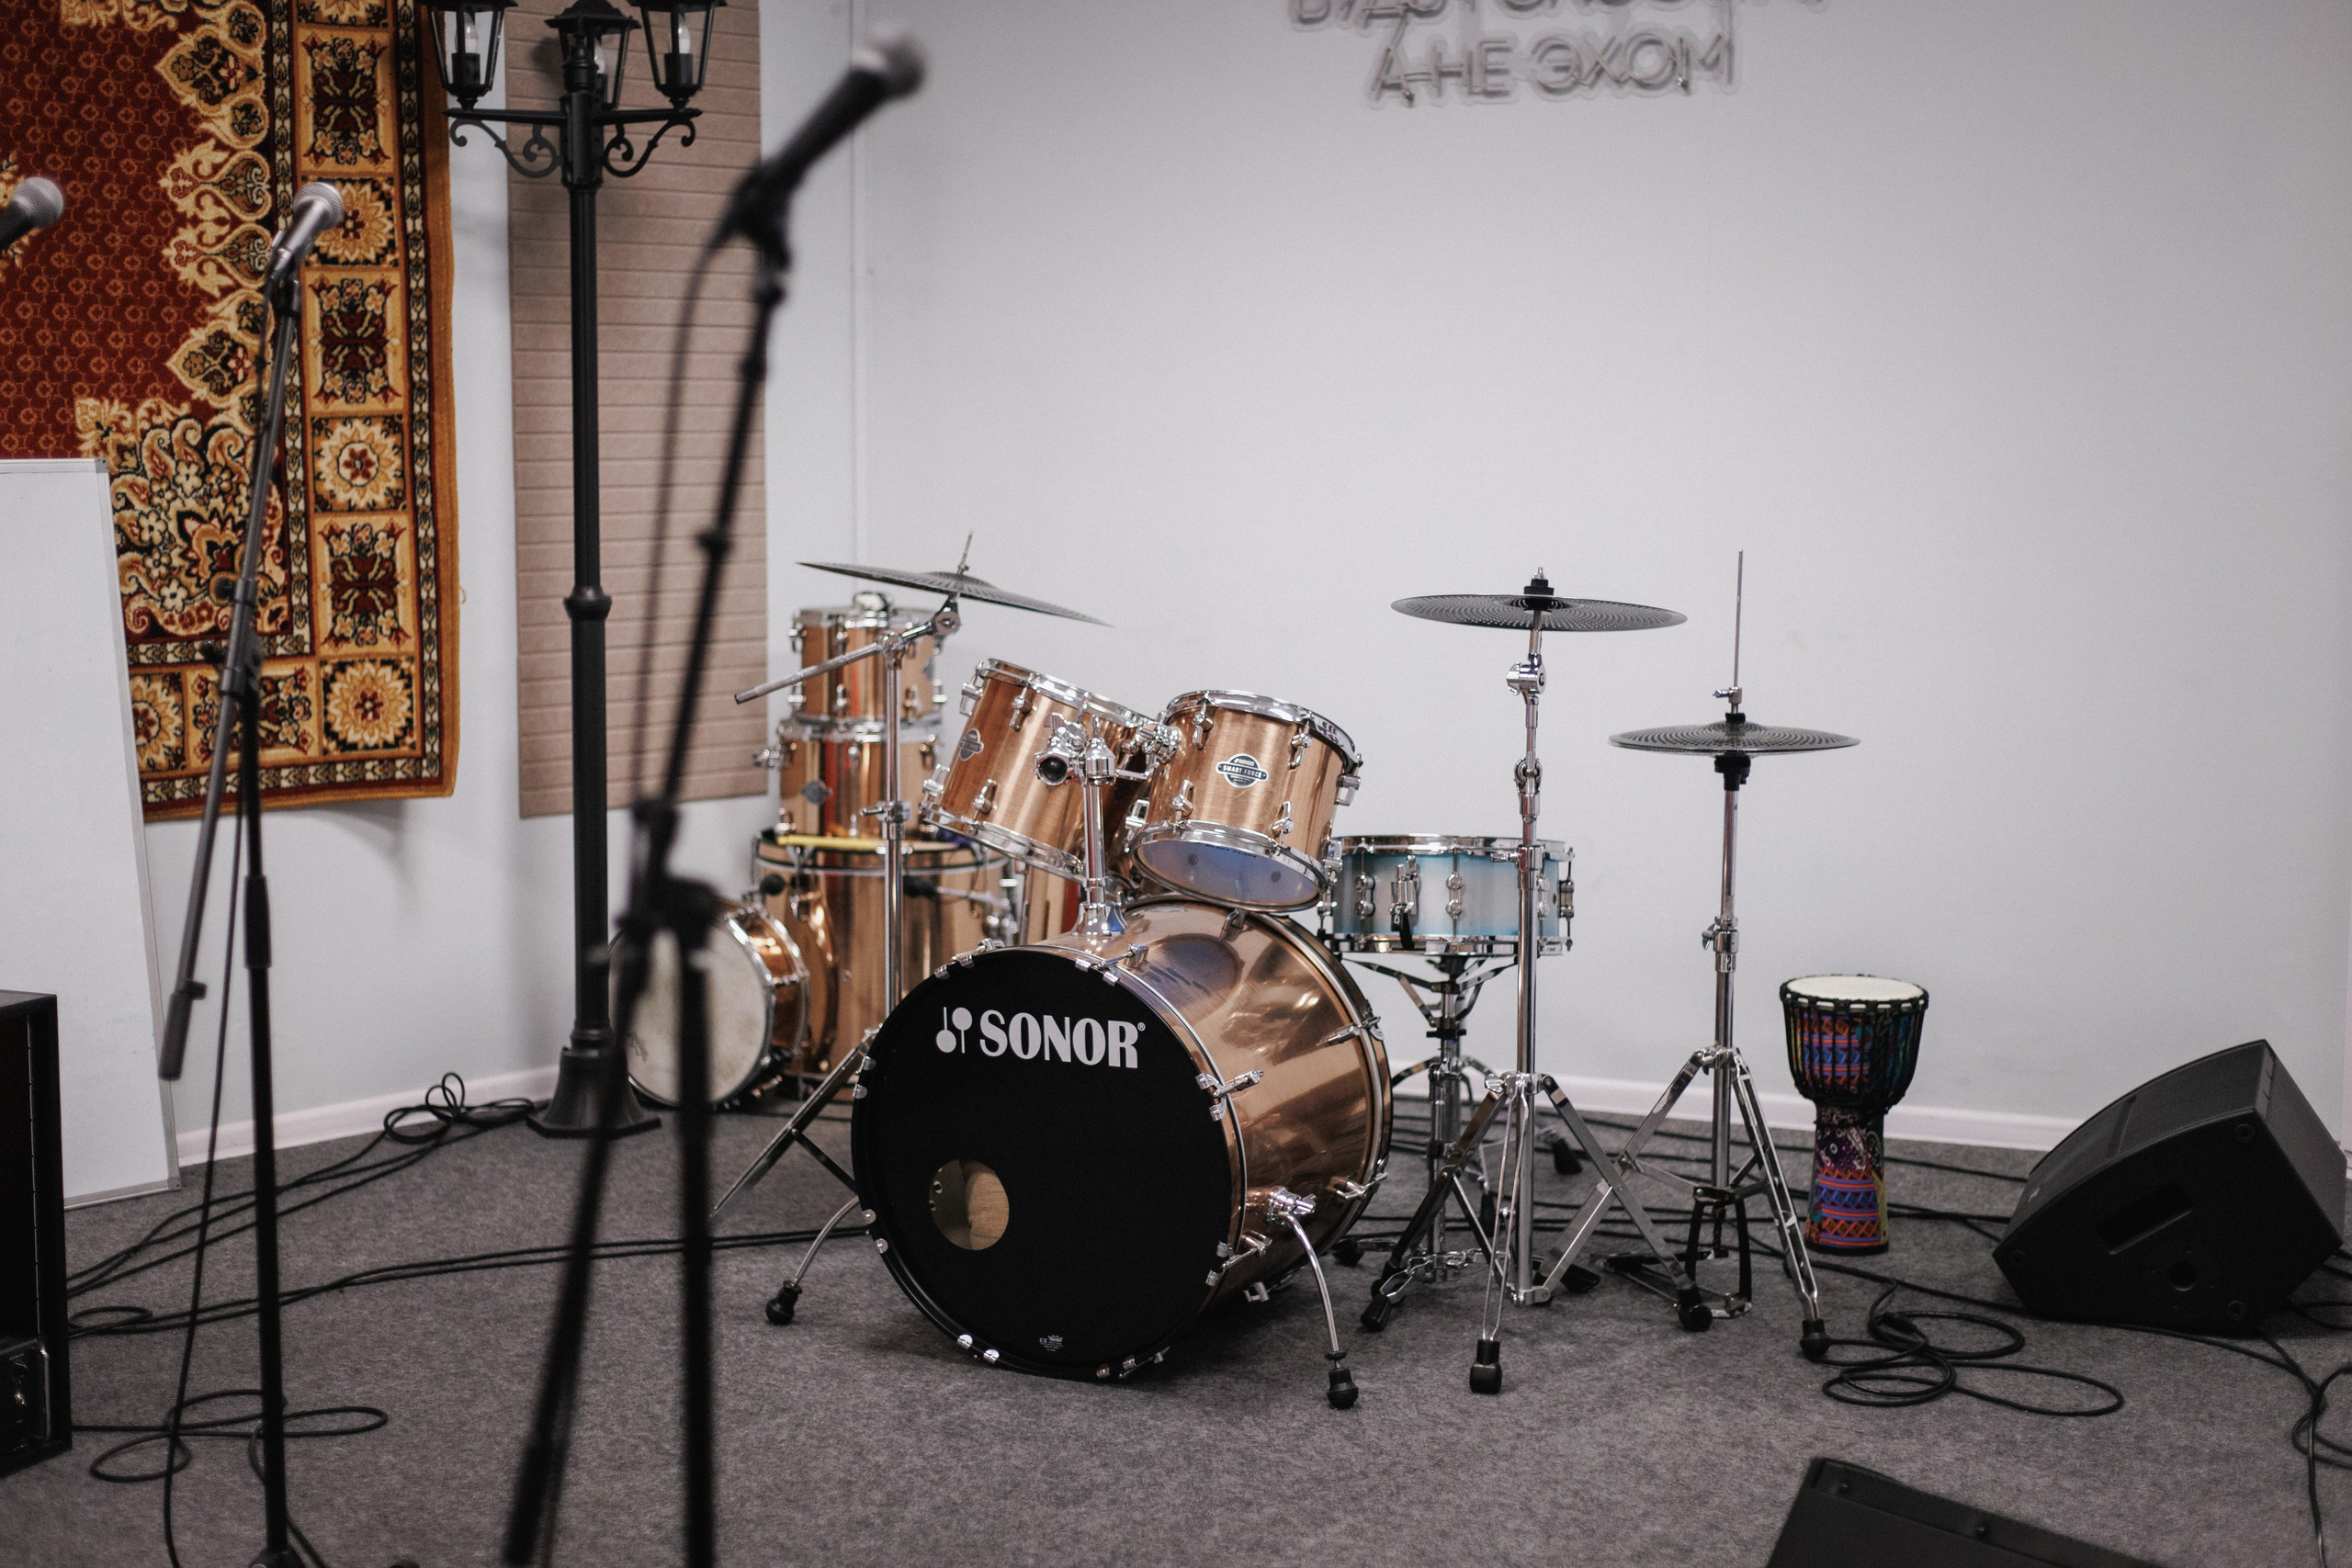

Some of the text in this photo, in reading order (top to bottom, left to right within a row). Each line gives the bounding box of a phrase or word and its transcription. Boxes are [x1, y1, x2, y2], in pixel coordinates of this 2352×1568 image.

[1430, 39, 1511, 97] НЕ
[1531, 31, 1732, 96] ЭХОМ
[1222, 764, 1243, 774] SMART
[1243, 769, 1262, 779] FORCE
